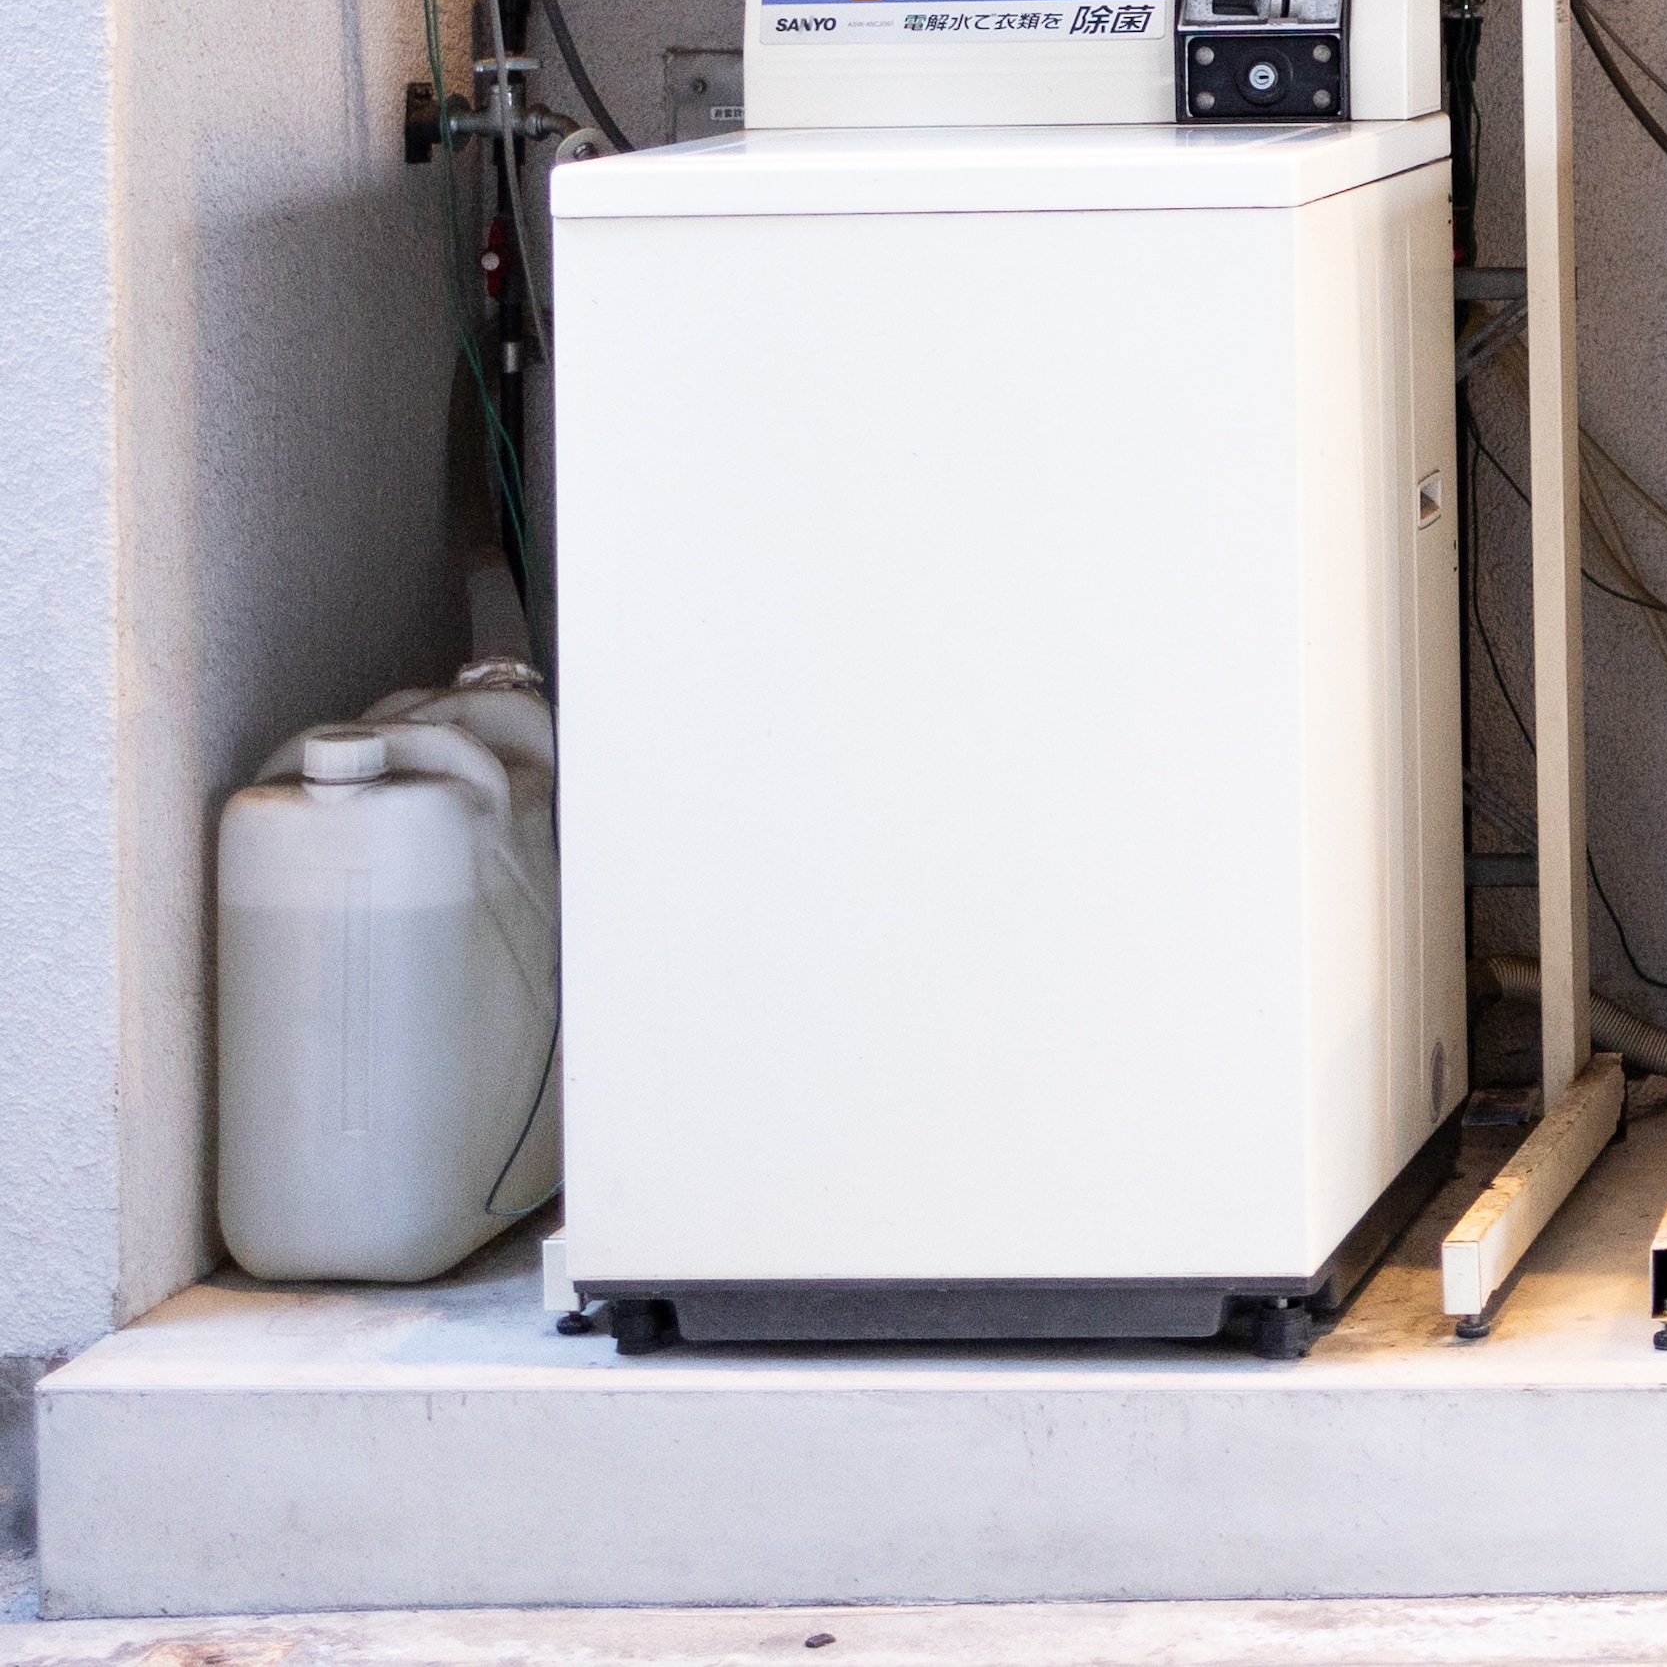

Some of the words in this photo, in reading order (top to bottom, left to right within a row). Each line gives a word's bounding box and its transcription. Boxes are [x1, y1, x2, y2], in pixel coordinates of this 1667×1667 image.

[775, 16, 837, 33] SANYO
[903, 11, 1064, 32] 電解水で衣類を
[1069, 4, 1155, 35] 除菌
